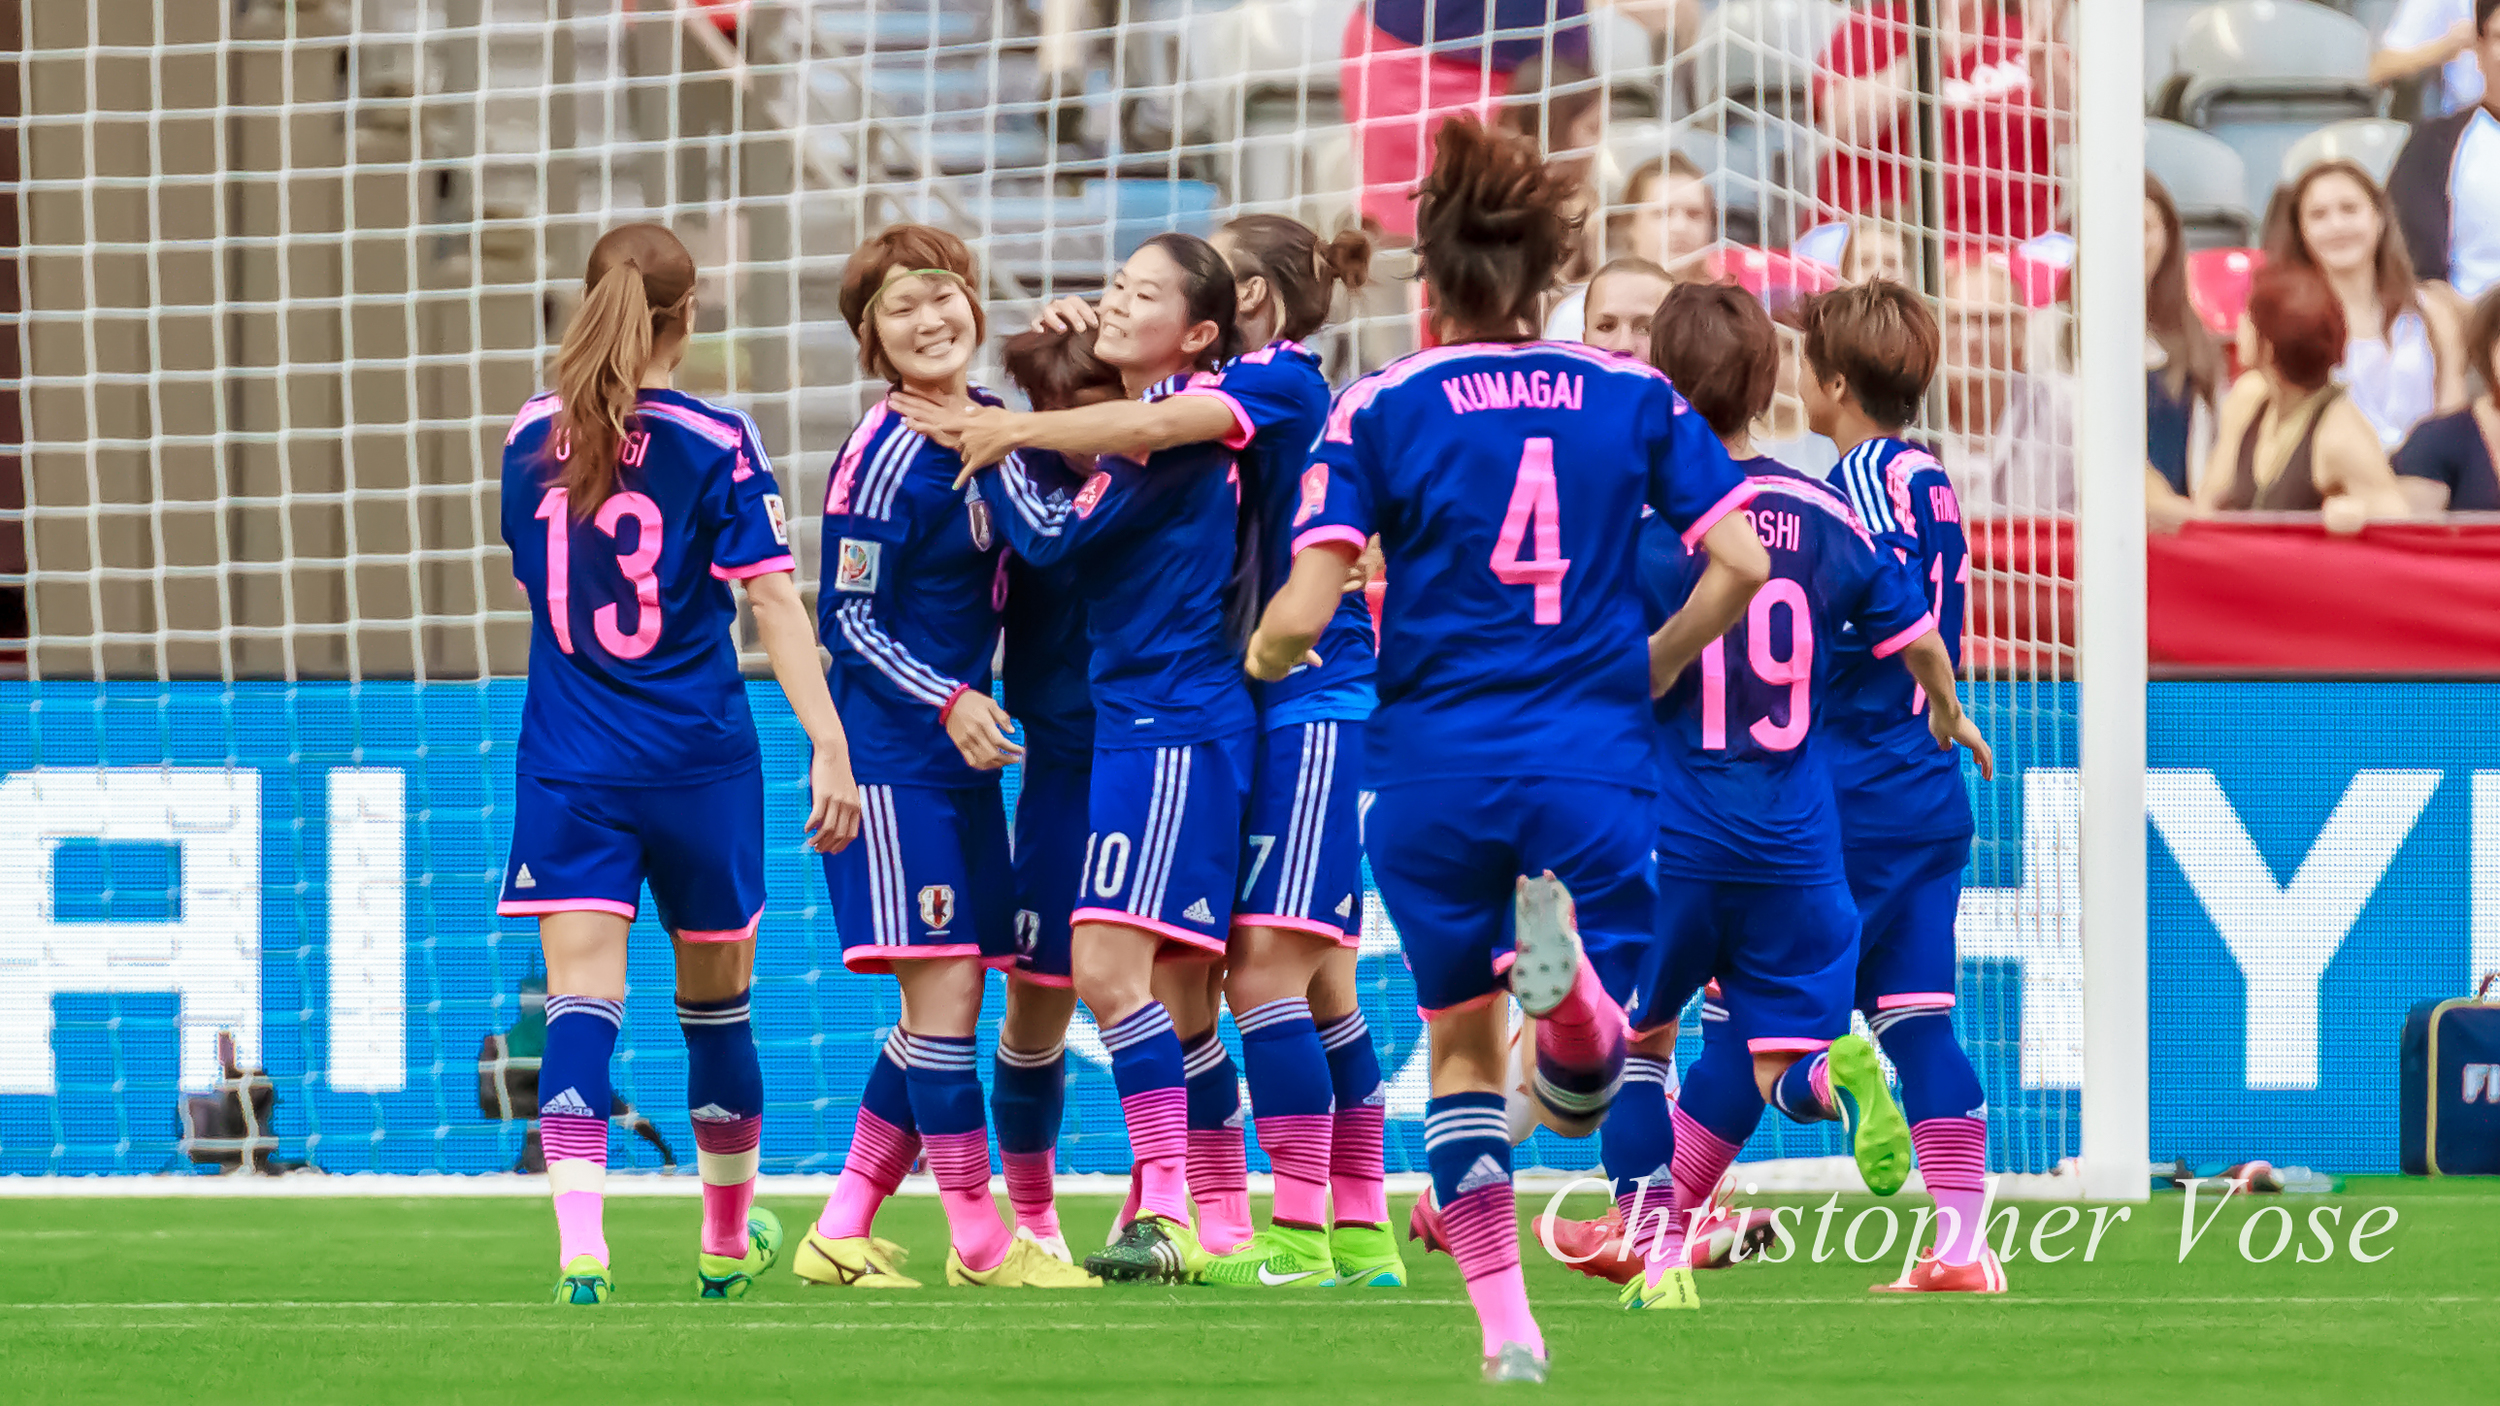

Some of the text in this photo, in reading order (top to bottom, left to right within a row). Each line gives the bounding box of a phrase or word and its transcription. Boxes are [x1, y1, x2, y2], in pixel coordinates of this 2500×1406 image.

[1441, 369, 1583, 414] KUMAGAI
[534, 487, 664, 659] 13
[1489, 436, 1571, 626] 4
[1702, 578, 1813, 751] 19
[1080, 831, 1131, 898] 10
[1242, 835, 1276, 901] 7
